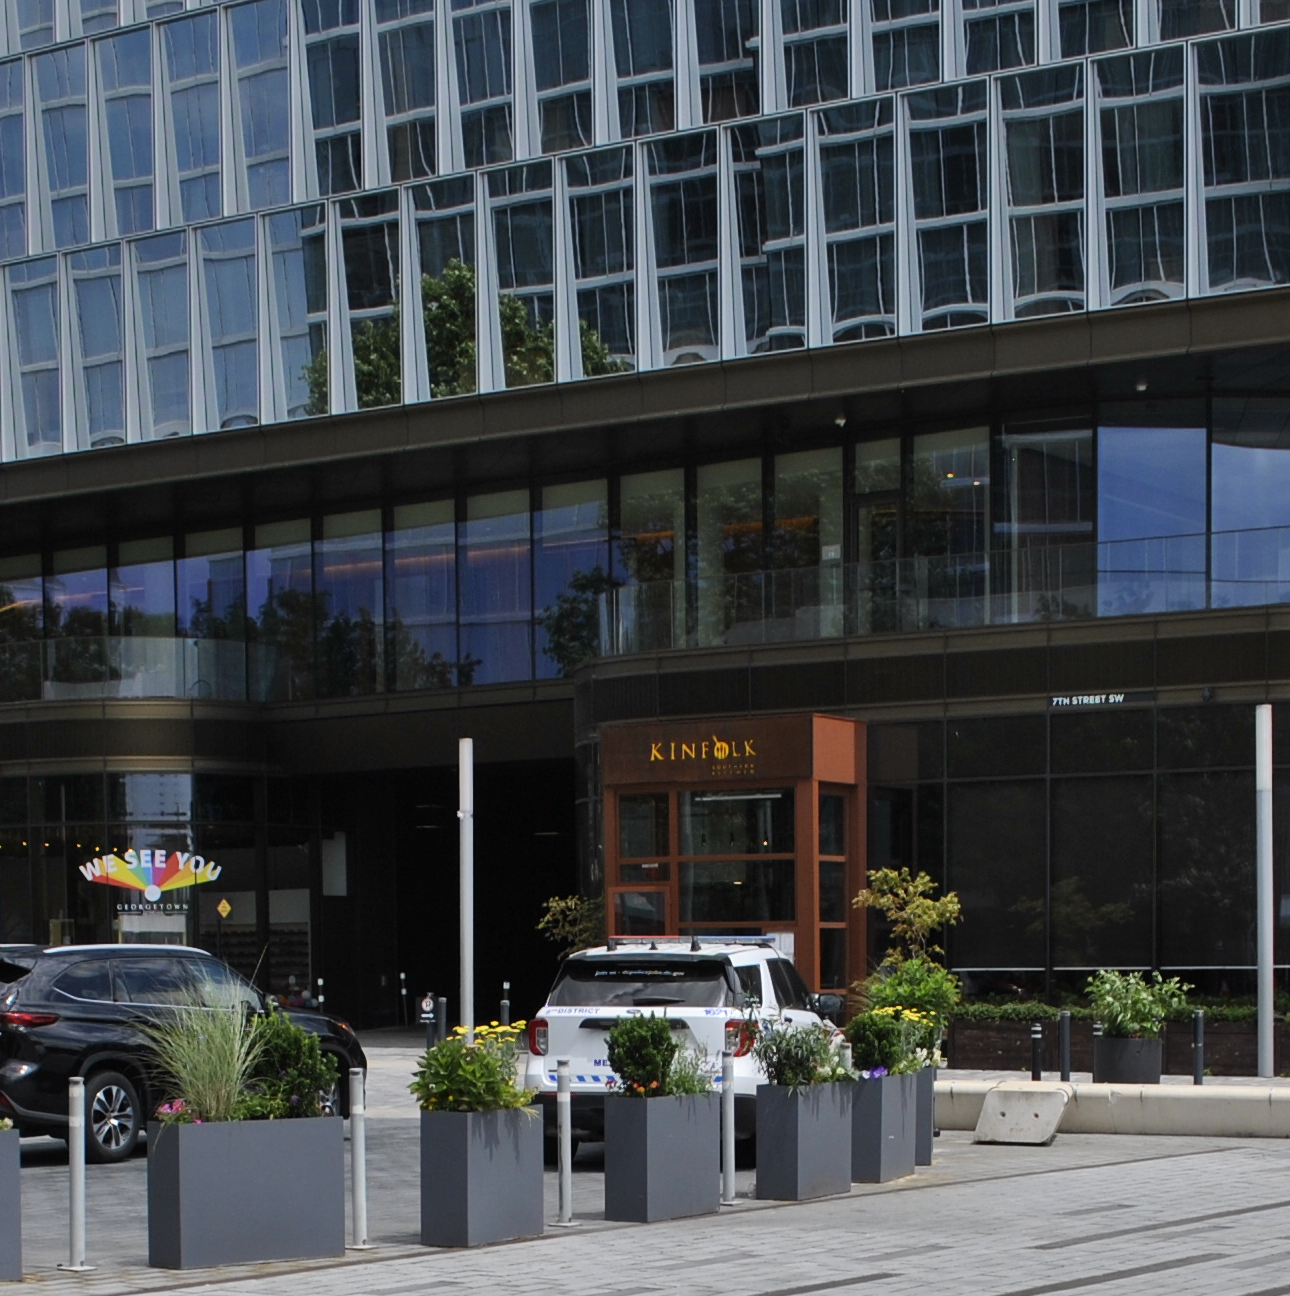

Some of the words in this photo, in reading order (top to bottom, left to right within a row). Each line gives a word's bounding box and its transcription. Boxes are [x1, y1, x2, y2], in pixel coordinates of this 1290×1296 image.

[1052, 697, 1069, 706] 7TH
[1072, 695, 1106, 705] STREET
[1109, 694, 1124, 703] SW
[649, 735, 757, 761] KINFOLK
[78, 853, 120, 881] WE
[124, 849, 167, 869] SEE
[175, 851, 223, 881] YOU
[116, 903, 189, 911] GEORGETOWN
